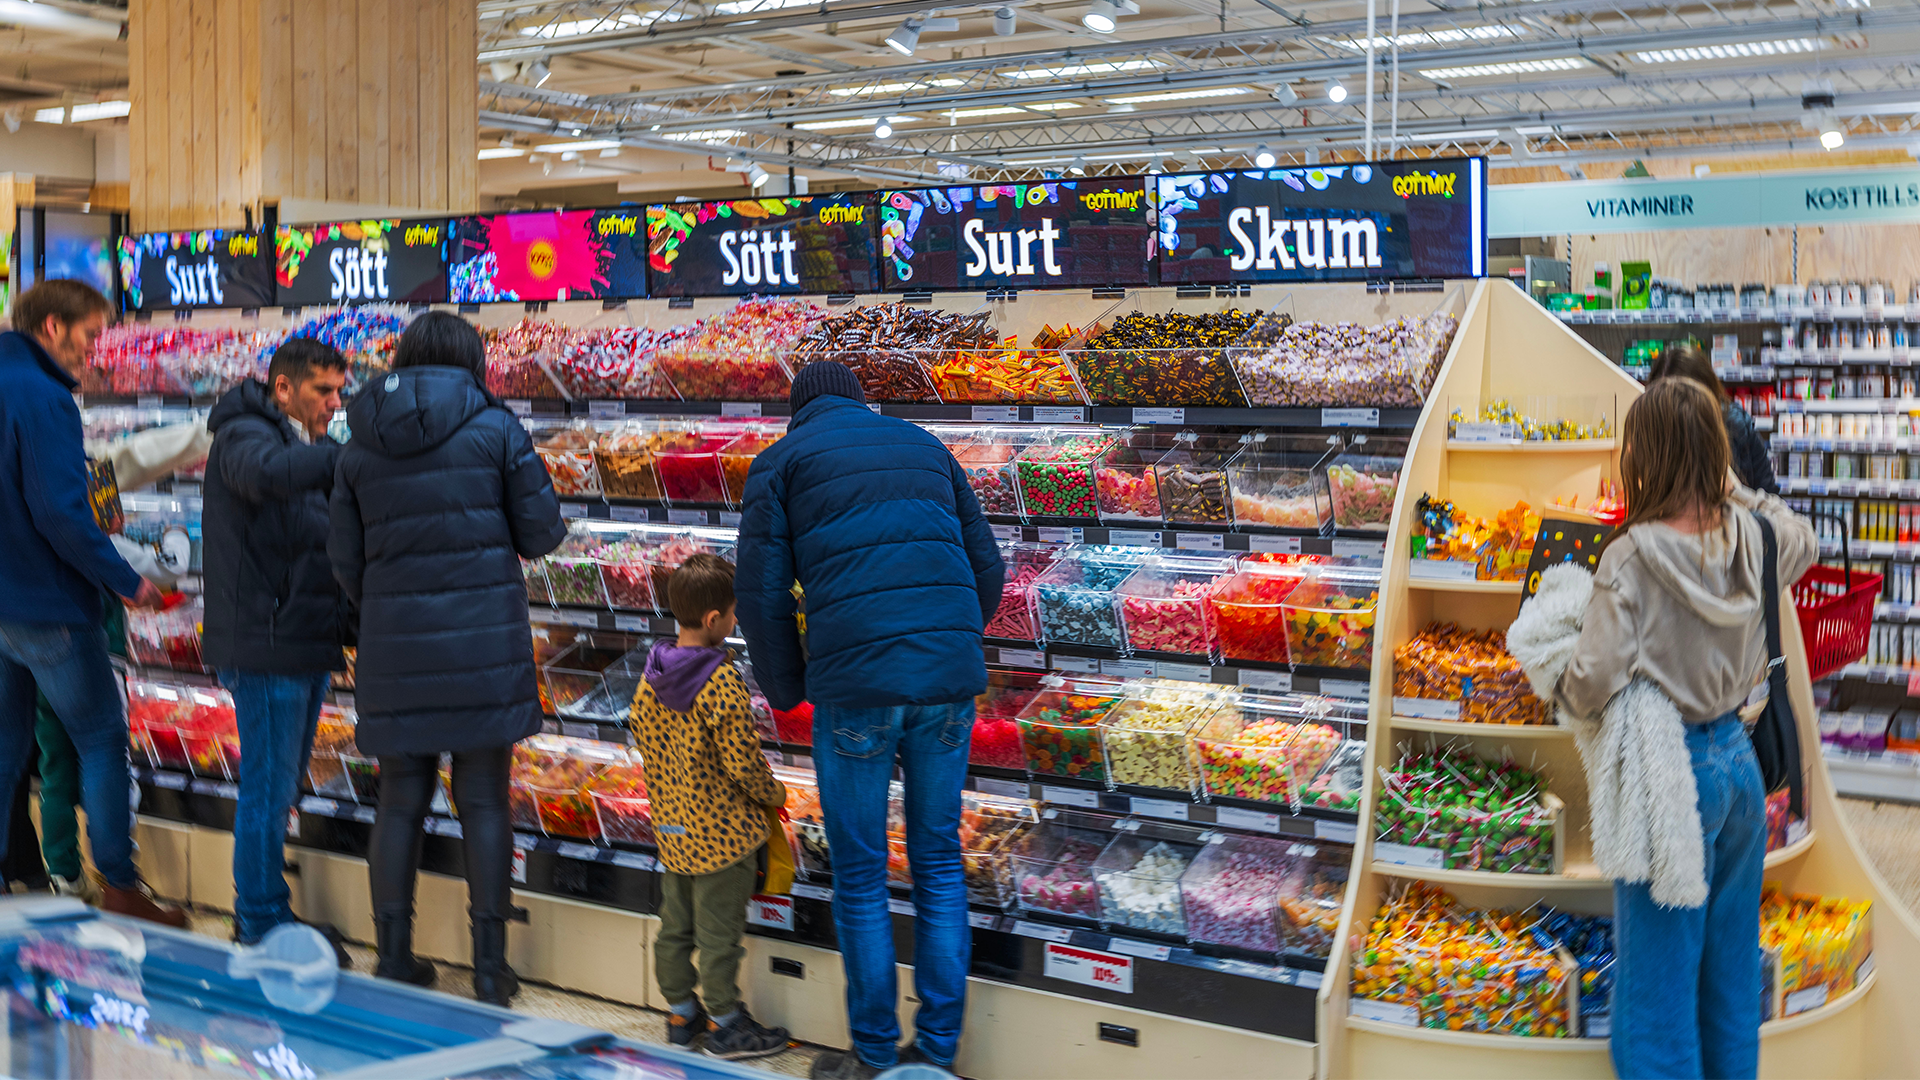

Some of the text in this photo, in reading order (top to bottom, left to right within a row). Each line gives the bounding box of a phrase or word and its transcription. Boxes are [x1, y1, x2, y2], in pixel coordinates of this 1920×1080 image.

[1086, 190, 1139, 210] GOTTMIX
[1392, 172, 1457, 196] GOTTMIX
[1805, 182, 1920, 212] KOSTTILLS
[819, 204, 865, 224] GOTTMIX
[1586, 193, 1695, 218] VITAMINER
[719, 229, 800, 286] Sött
[963, 217, 1063, 277] Surt
[1228, 205, 1383, 271] Skum
[165, 254, 224, 306] Surt
[328, 246, 390, 300] Sött
